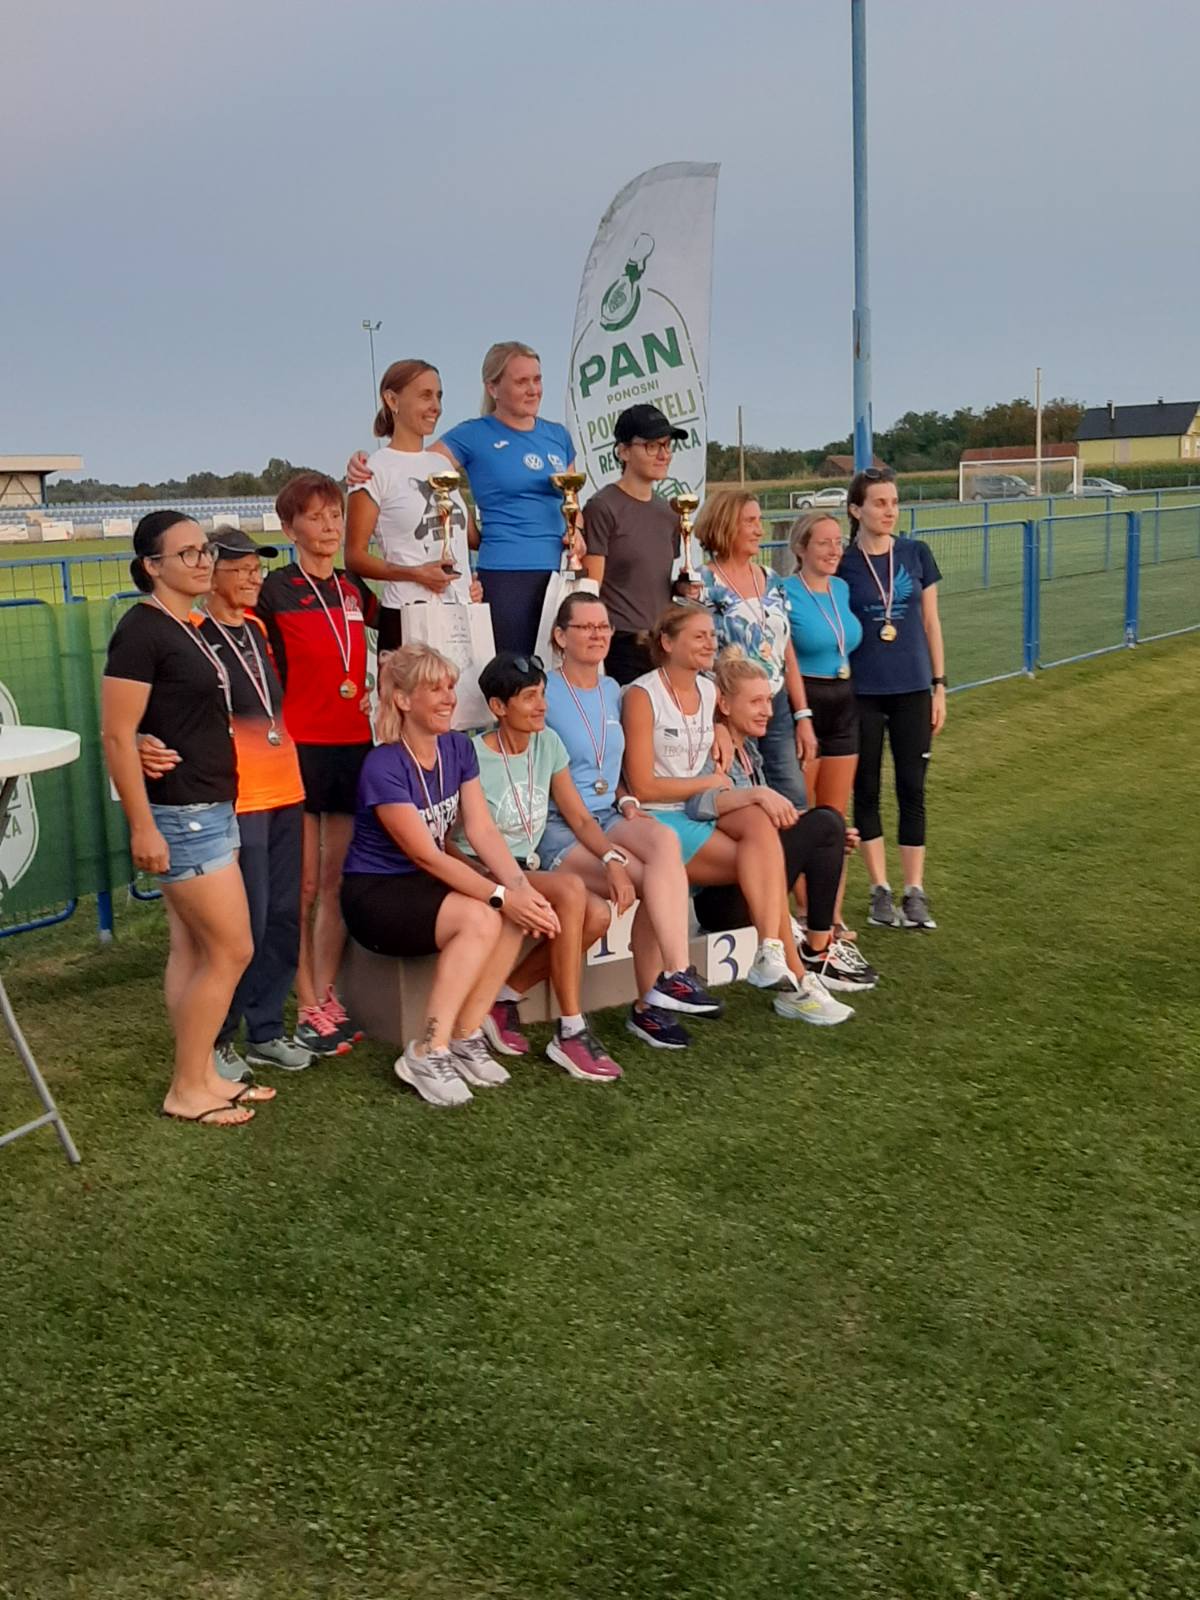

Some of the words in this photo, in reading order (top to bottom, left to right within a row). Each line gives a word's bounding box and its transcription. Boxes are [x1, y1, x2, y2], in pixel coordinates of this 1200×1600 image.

[579, 326, 684, 398] PAN
[607, 379, 660, 405] PONOSNI
[713, 933, 739, 982] 3
